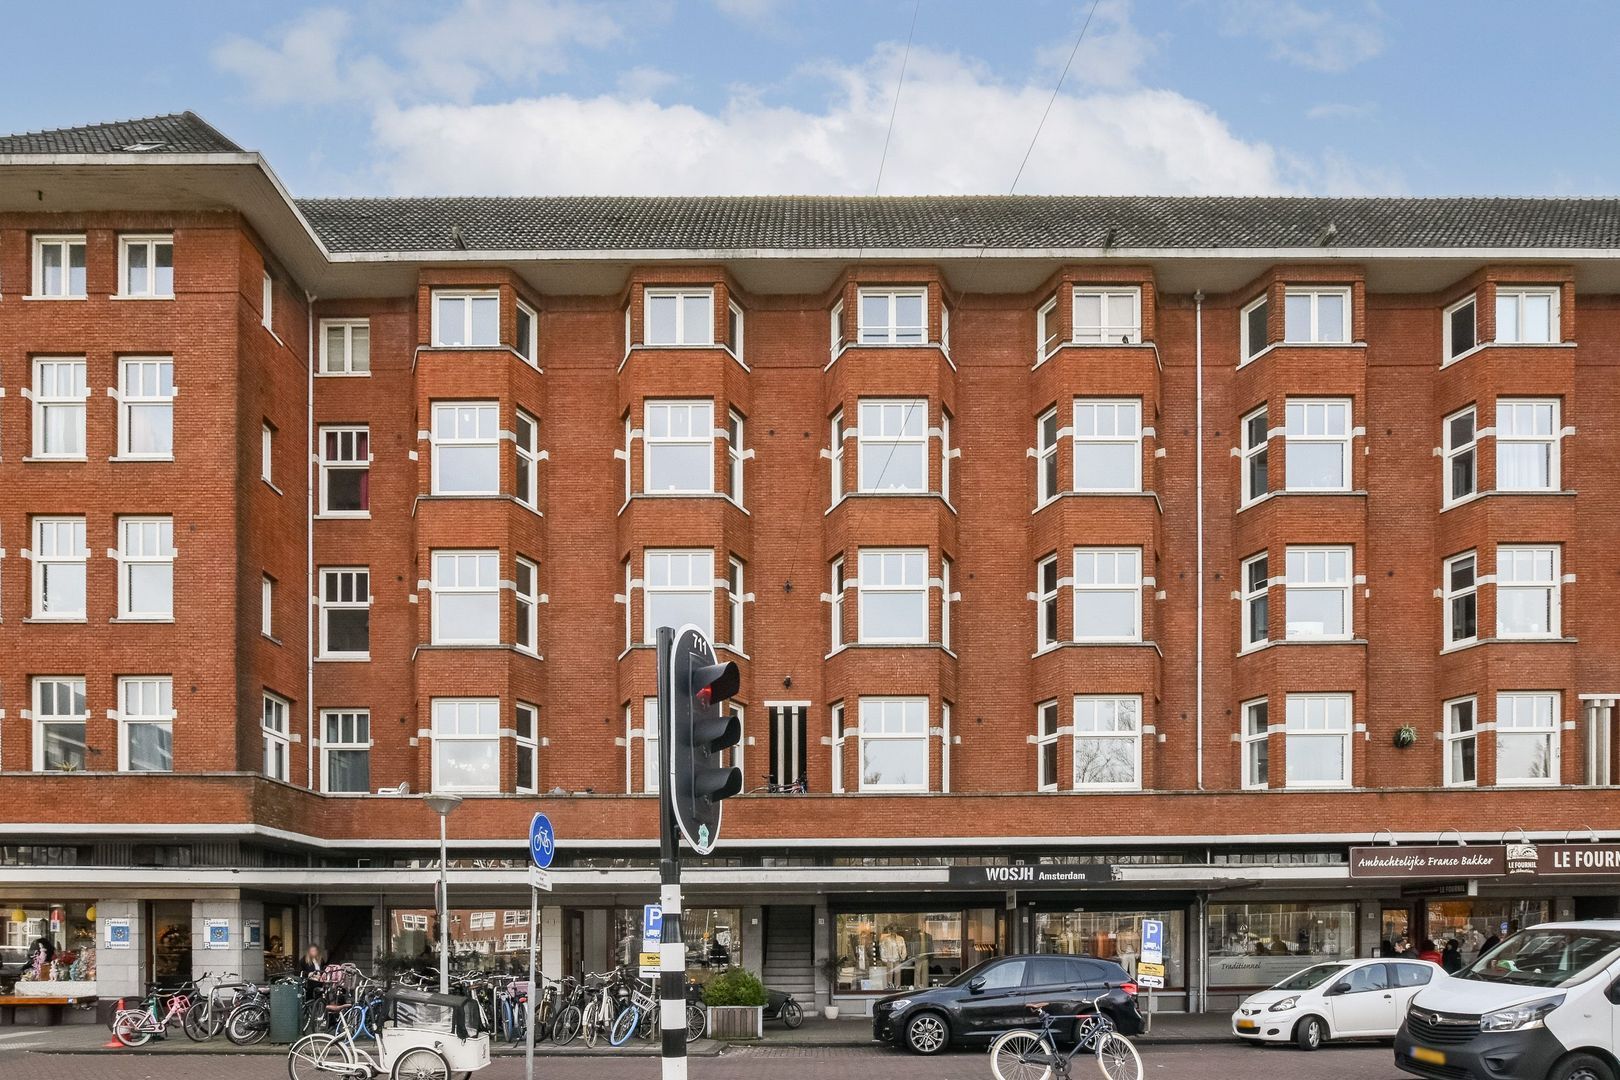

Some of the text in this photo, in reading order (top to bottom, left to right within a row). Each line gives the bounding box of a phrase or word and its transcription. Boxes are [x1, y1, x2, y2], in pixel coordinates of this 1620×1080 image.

[692, 632, 707, 656] 711
[1358, 854, 1494, 871] Ambachtelijke Franse Bakker
[1508, 861, 1537, 869] LE FOURNIL
[1554, 851, 1571, 868] LE
[985, 866, 1086, 881] WOSJH Amsterdam
[649, 907, 663, 927] P
[1146, 922, 1159, 939] P
[1221, 961, 1261, 970] Traditionnel
